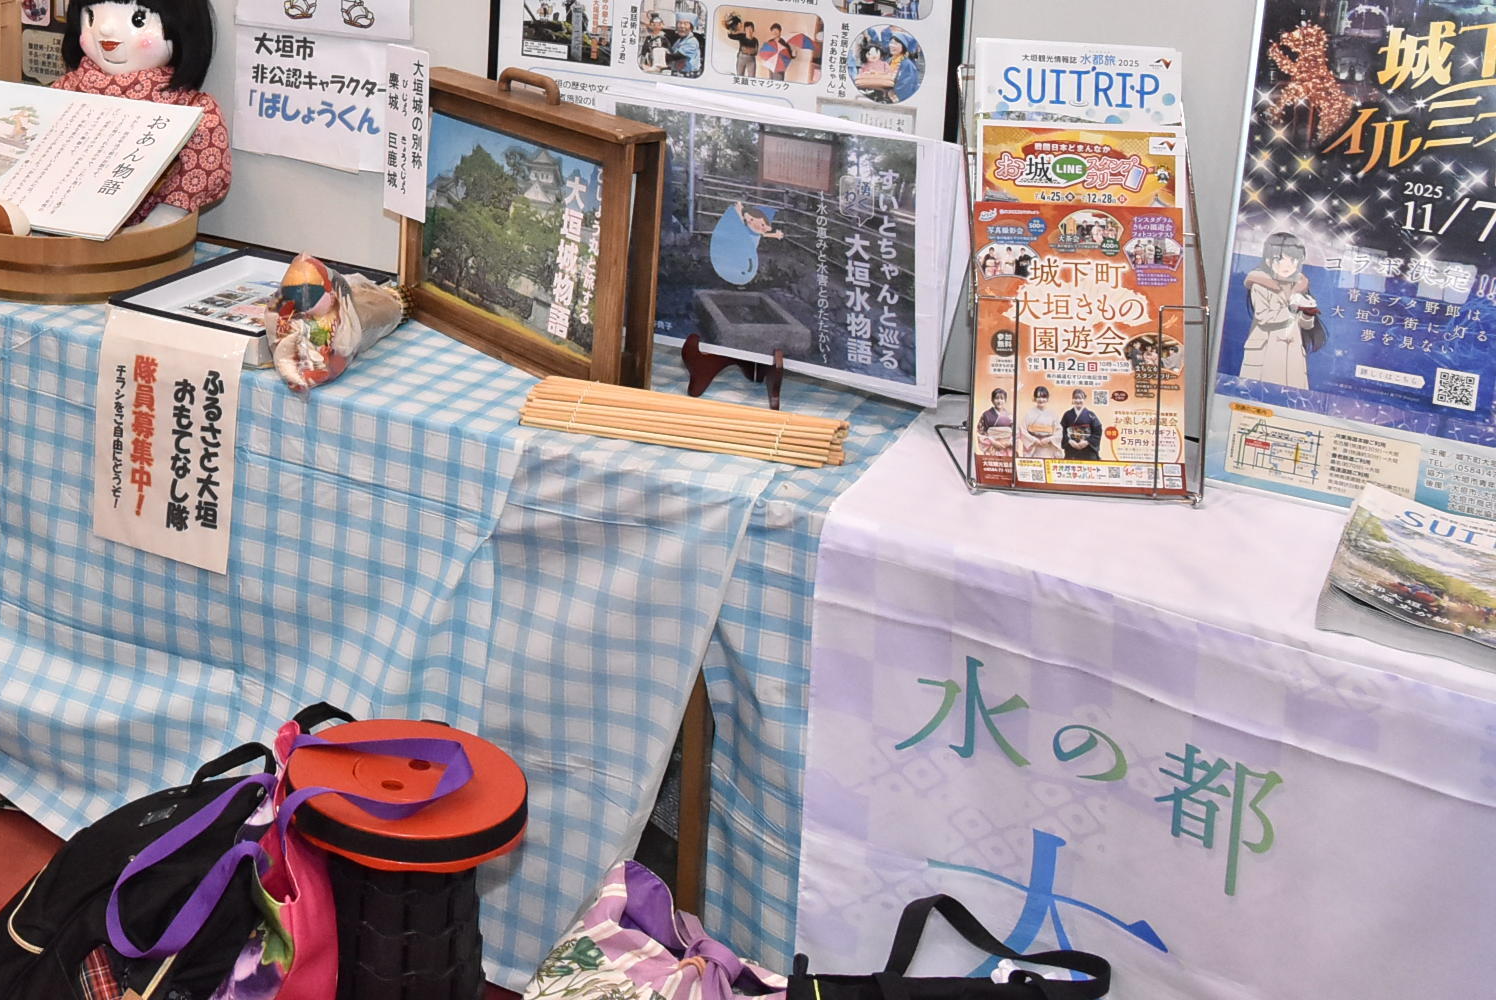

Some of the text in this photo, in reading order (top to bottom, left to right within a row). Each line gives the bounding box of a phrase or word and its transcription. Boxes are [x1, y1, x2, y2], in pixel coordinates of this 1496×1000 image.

[253, 32, 316, 62] 大垣市
[1021, 53, 1140, 68] 大垣観光情報誌 水都旅 2025
[251, 65, 386, 97] 非公認キャラクター
[731, 77, 791, 91] 笑顔でマジック
[997, 65, 1160, 109] SUITRIP
[411, 59, 425, 170] 大垣城の別称
[97, 114, 171, 197] おあん物語
[387, 132, 399, 189] 巨鹿城
[995, 153, 1052, 182] お城
[1055, 163, 1084, 175] LINE
[1404, 182, 1444, 199] 2025
[547, 176, 590, 340] 大垣城物語
[878, 168, 900, 371] すいとちゃんと巡る
[1029, 258, 1126, 289] 城下町
[844, 233, 873, 366] 大垣水物語
[1012, 292, 1146, 321] 大垣きもの
[1346, 288, 1482, 322] 青春ブタ野郎は
[1330, 304, 1488, 342] 大垣の街に灯る
[1032, 325, 1126, 356] 園遊会
[1360, 328, 1455, 354] 夢を見ない
[165, 378, 196, 532] おもてなし隊
[194, 369, 225, 531] ふるさと大垣
[1429, 458, 1444, 468] TEL
[894, 654, 1284, 897] 水の都
